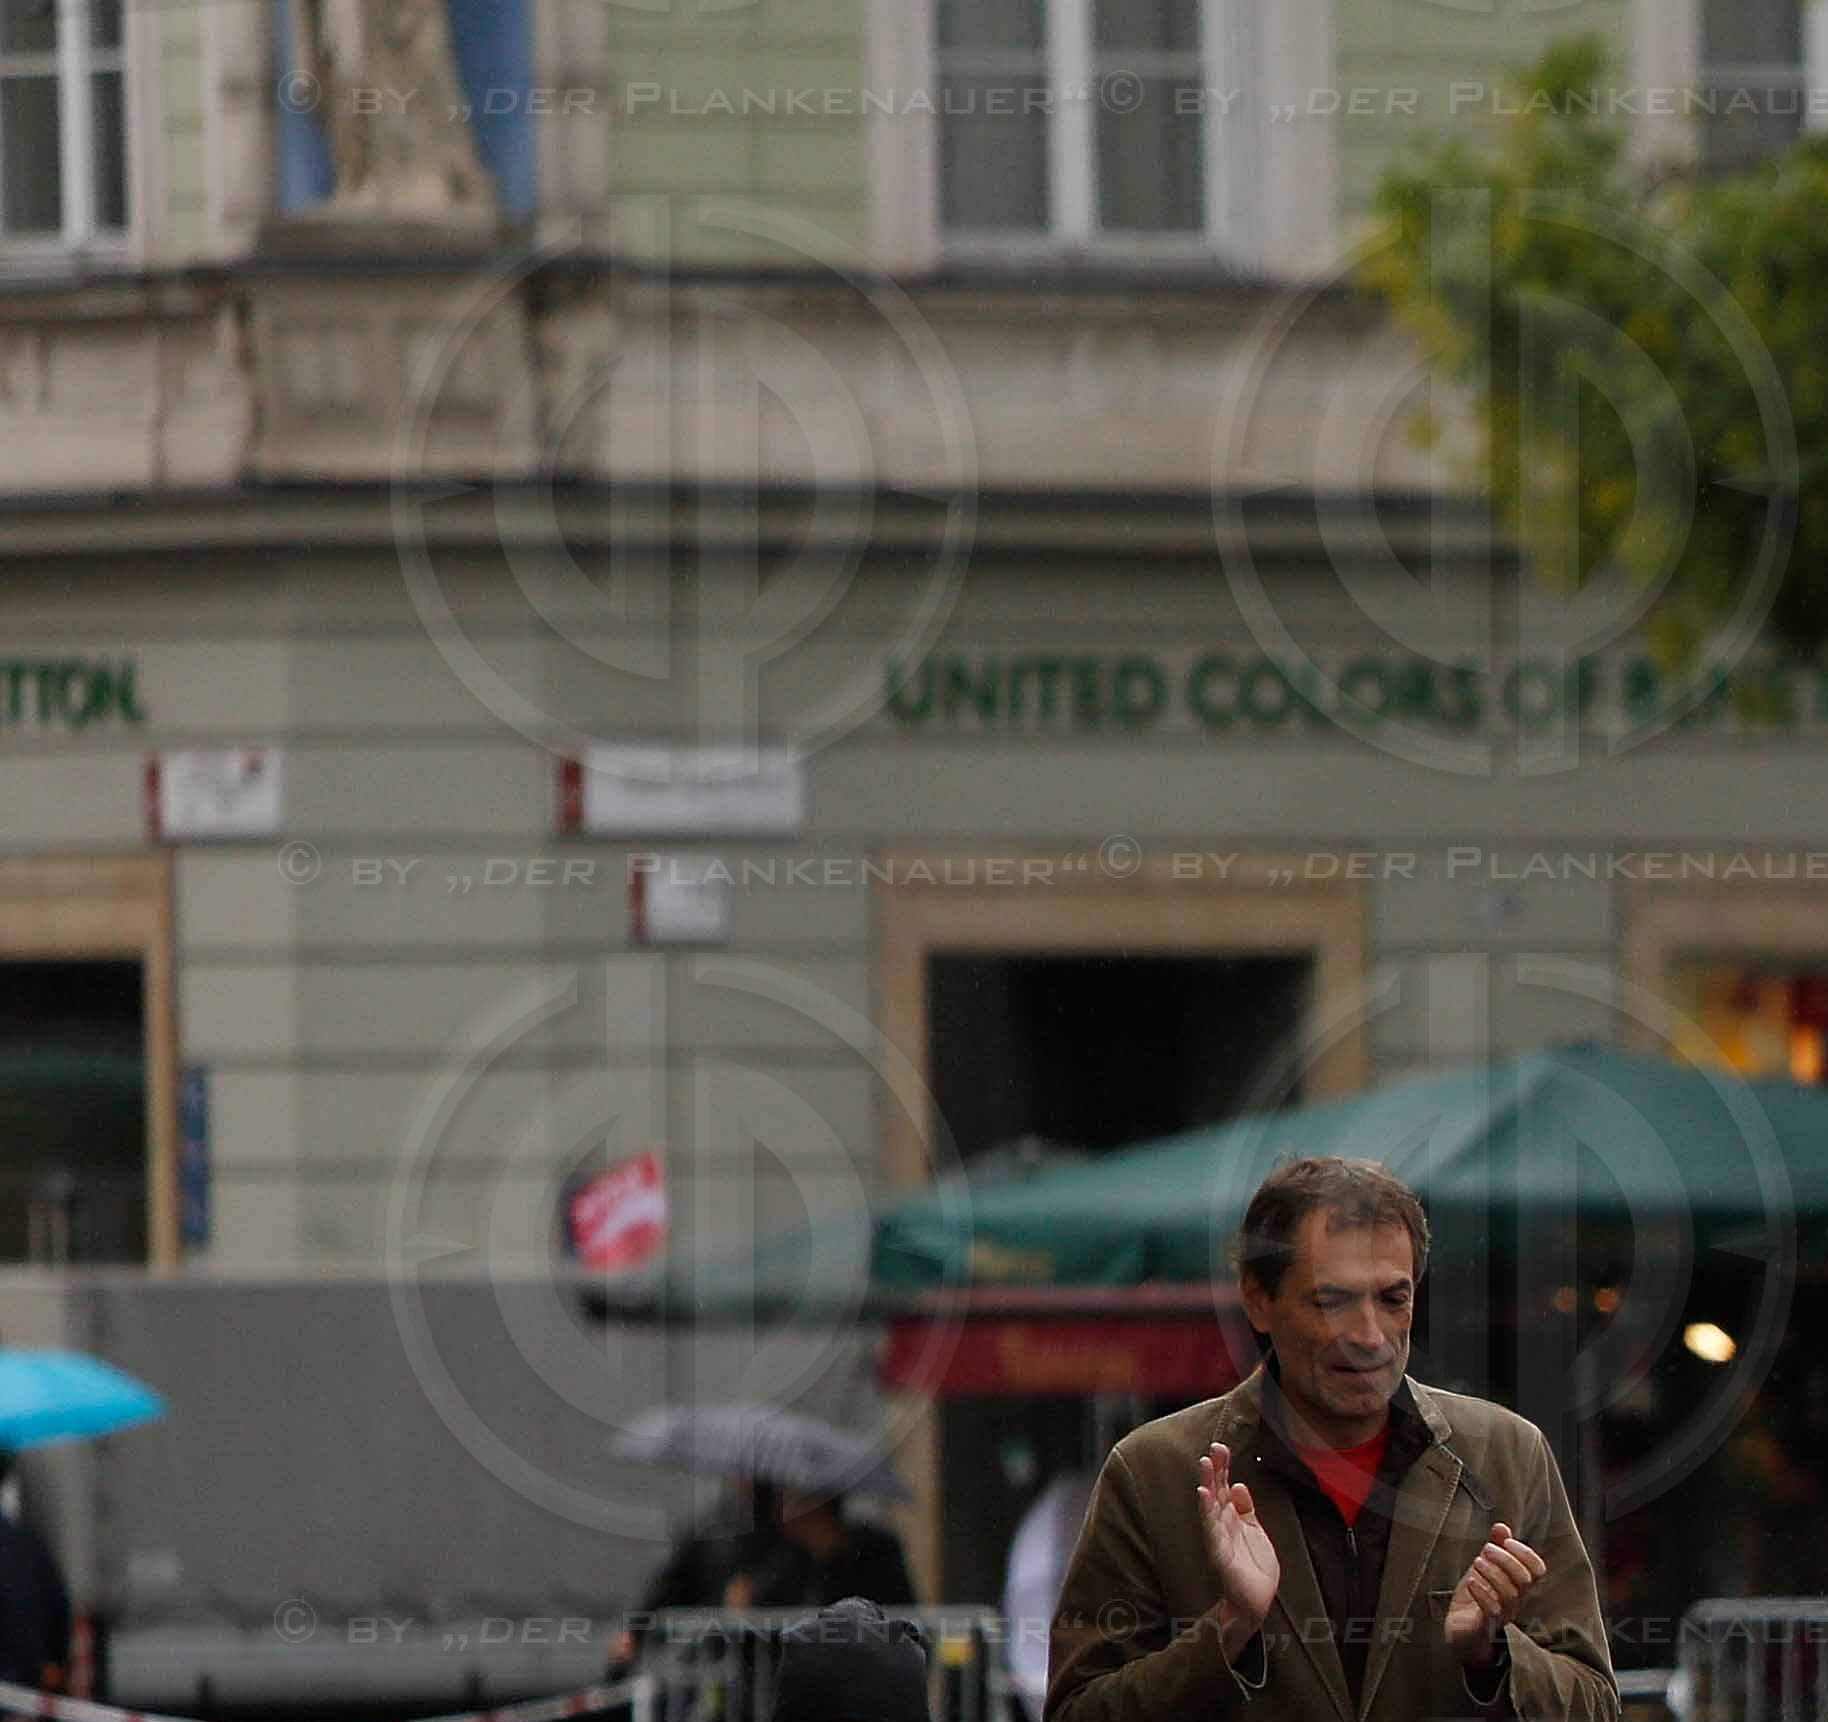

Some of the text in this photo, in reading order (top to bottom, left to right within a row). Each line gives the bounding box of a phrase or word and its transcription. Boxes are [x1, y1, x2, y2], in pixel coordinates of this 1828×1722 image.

[884, 655, 1168, 729] UNITED
[1190, 655, 1482, 732] COLORS
[1502, 656, 1604, 734] OF
